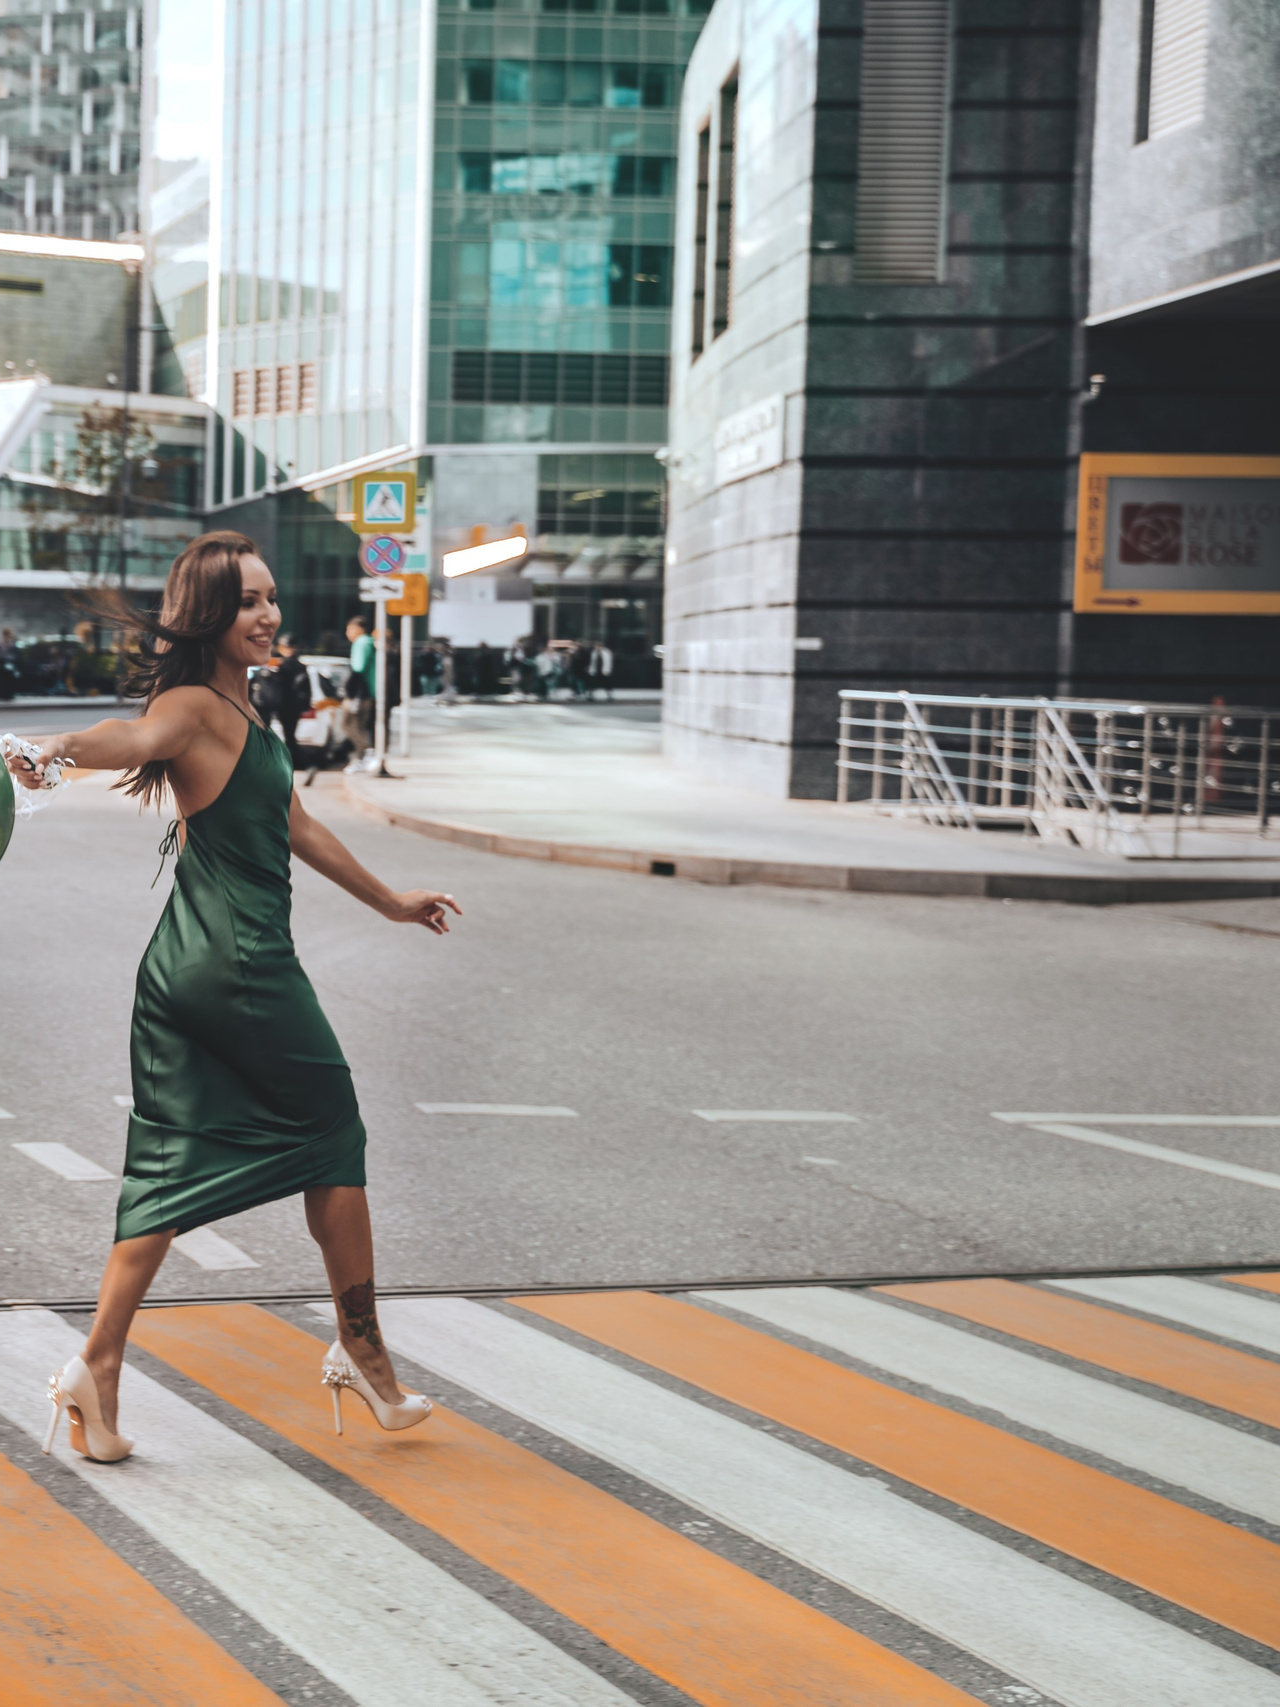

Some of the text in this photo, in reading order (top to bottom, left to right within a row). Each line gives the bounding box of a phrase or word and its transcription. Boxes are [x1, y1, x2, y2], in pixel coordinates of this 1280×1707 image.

[1188, 503, 1280, 525] MAISO
[1230, 523, 1260, 544] LA
[1188, 543, 1261, 567] ROSE
